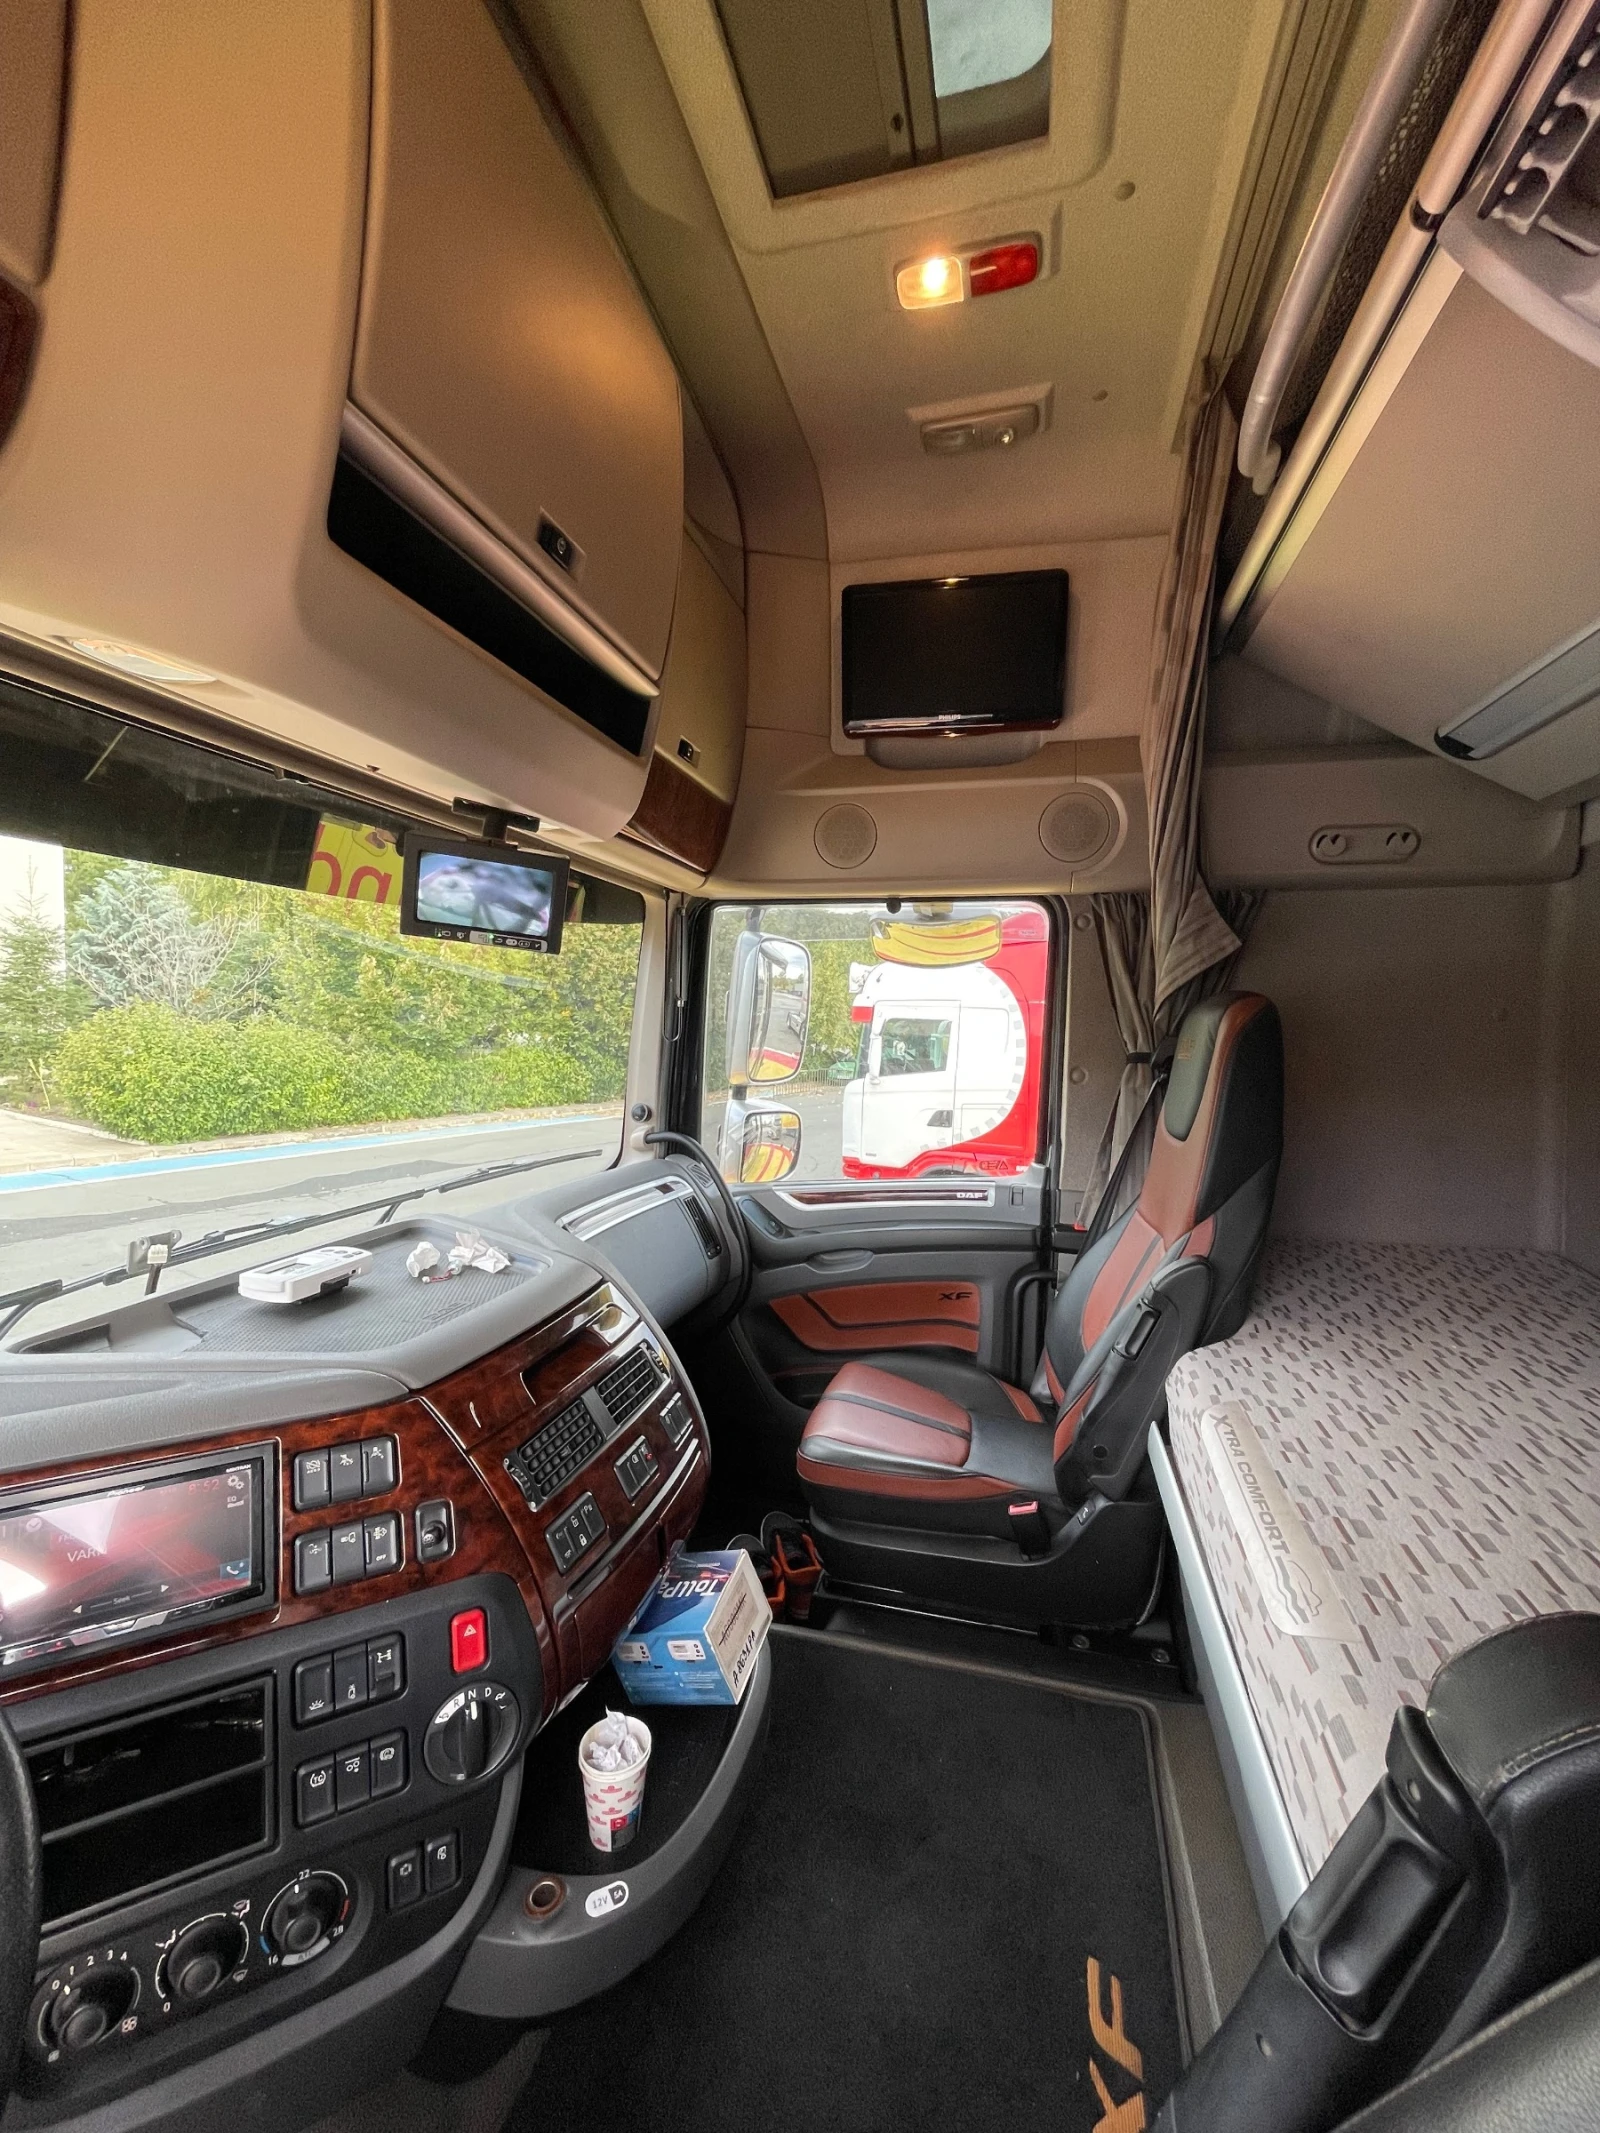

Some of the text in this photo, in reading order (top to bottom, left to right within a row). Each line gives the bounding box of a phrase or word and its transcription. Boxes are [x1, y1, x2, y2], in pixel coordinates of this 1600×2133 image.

[938, 1291, 973, 1301] XF
[1209, 1413, 1291, 1555] XTRA COMFORT
[106, 1485, 146, 1498] Pioneer
[375, 1554, 386, 1562] OFF
[113, 1595, 131, 1605] Seek
[468, 1688, 476, 1700] N
[485, 1687, 492, 1697] D
[453, 1699, 460, 1708] R
[299, 1869, 310, 1880] 22
[593, 1896, 608, 1909] 12V
[107, 1950, 113, 1960] 3
[120, 1951, 127, 1961] 4
[268, 1954, 279, 1966] 16
[87, 1955, 94, 1966] 2
[69, 1966, 75, 1975] 1
[52, 1980, 60, 1990] 0
[163, 2002, 171, 2012] 0
